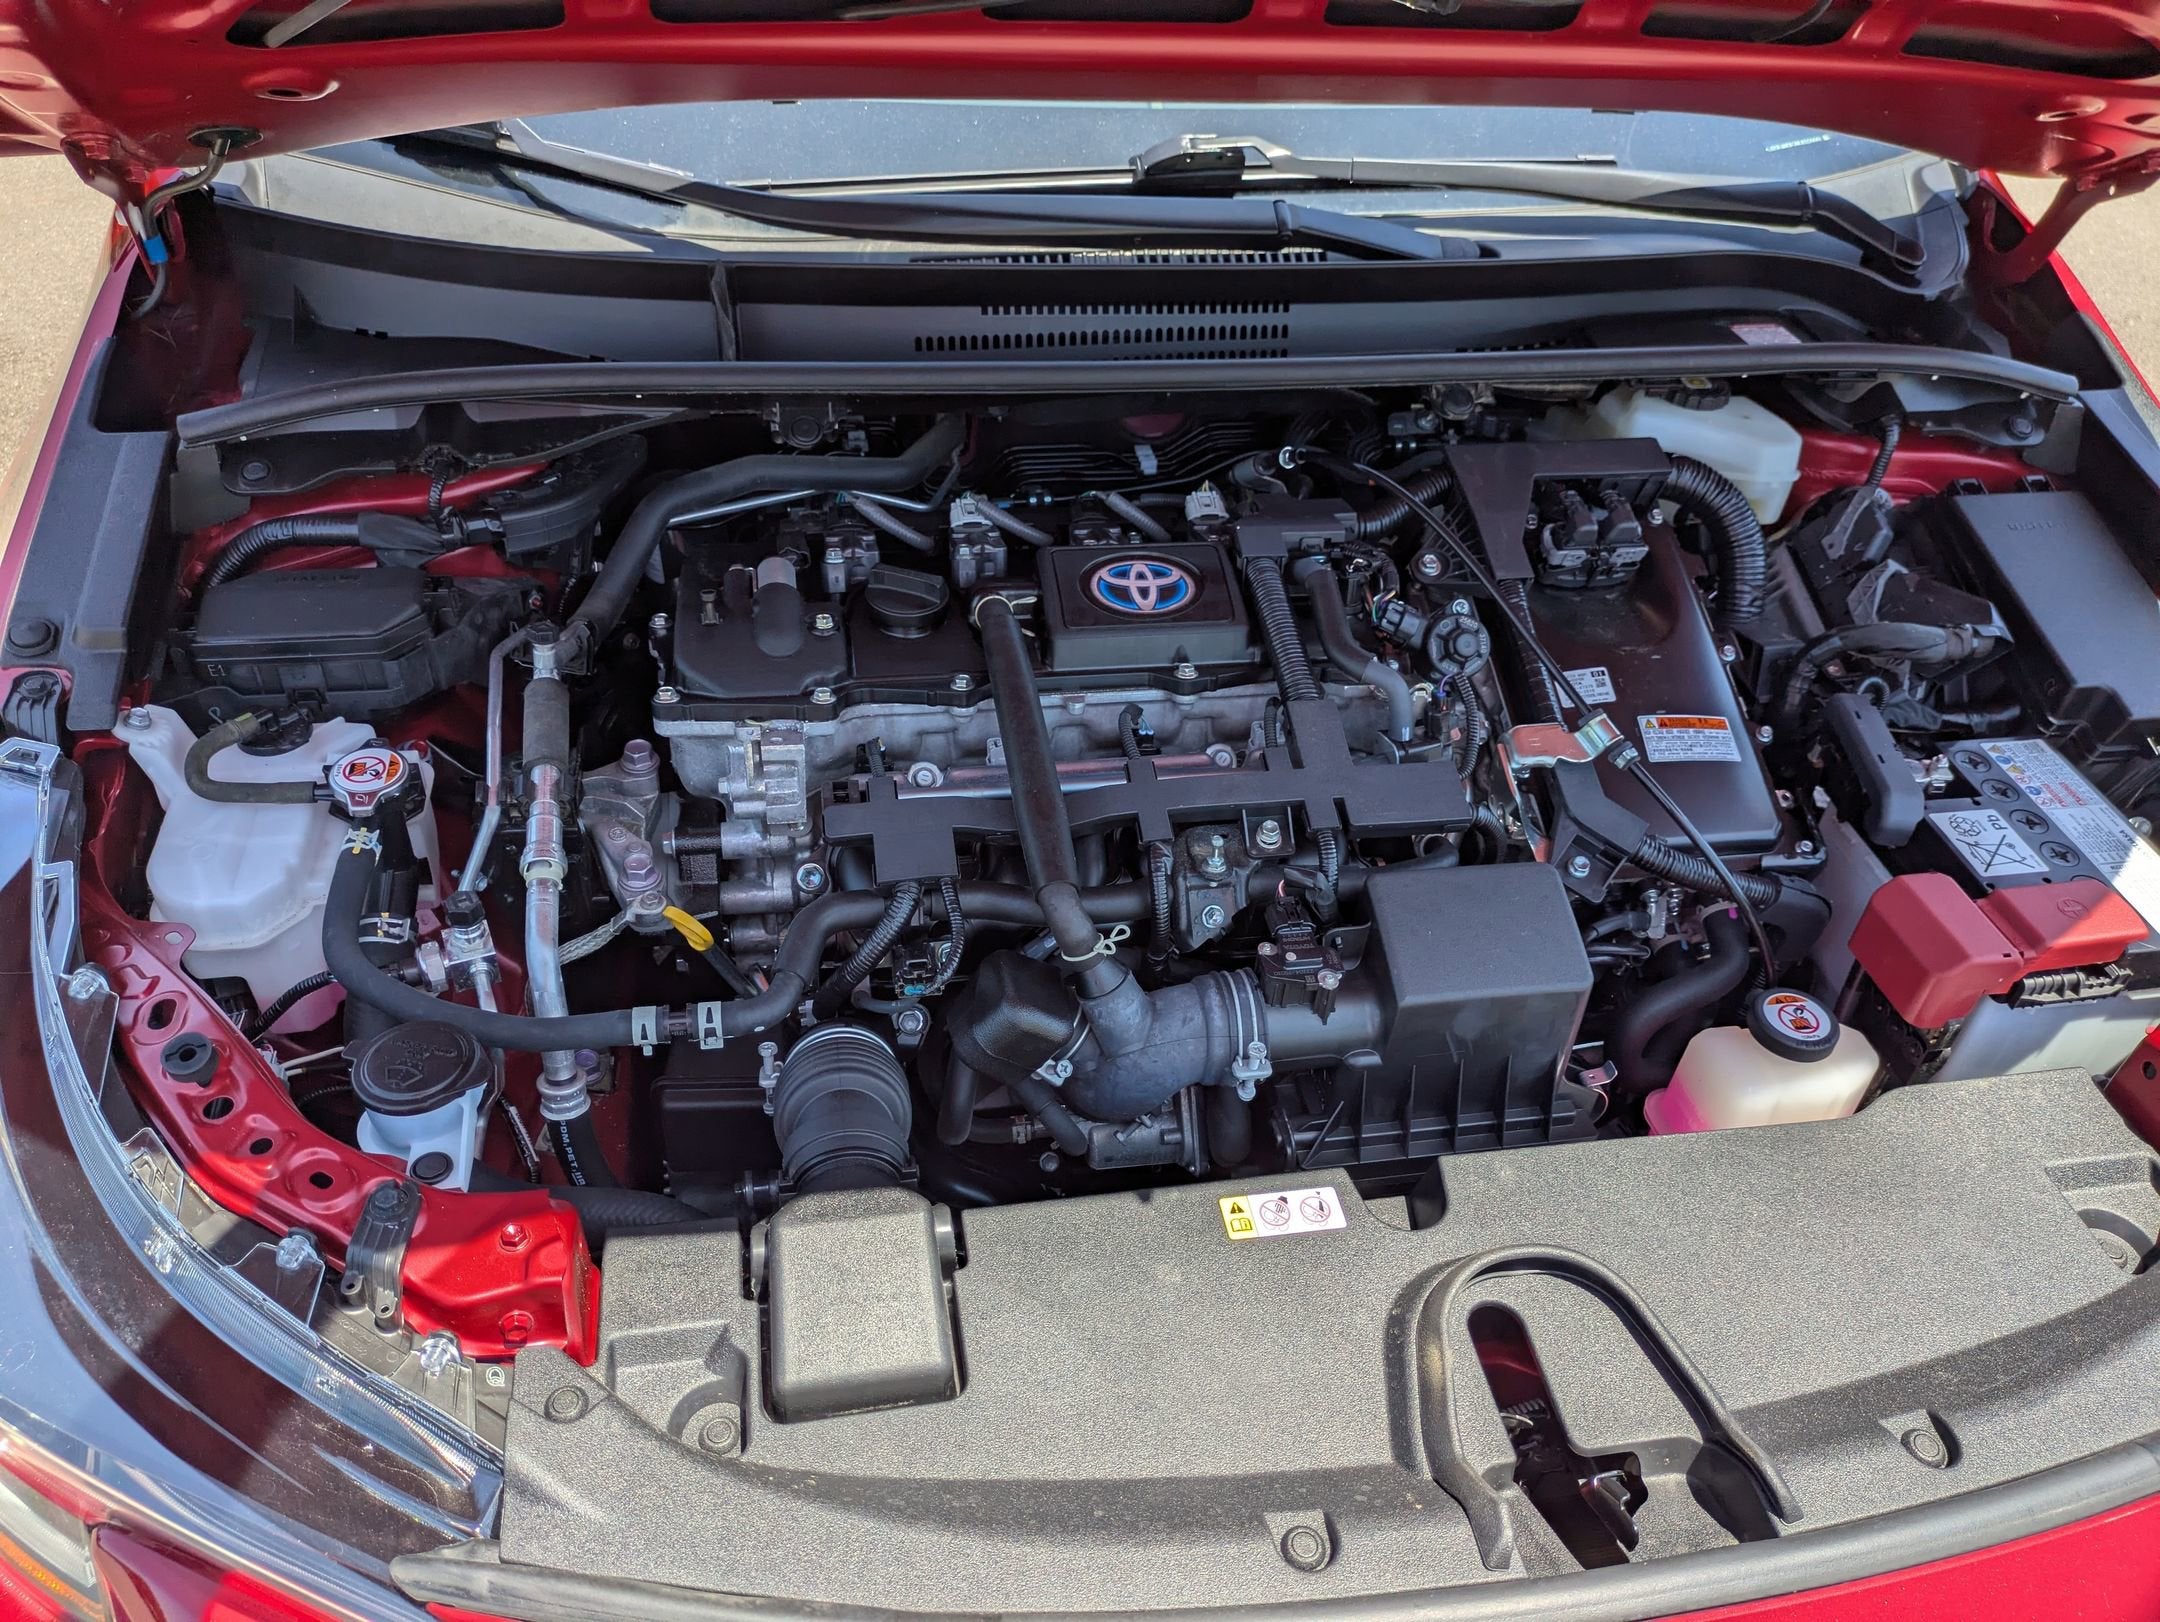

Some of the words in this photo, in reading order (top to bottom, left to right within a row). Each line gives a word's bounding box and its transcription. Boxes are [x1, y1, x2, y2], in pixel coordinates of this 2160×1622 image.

[1459, 616, 1478, 629] 25620
[207, 664, 226, 677] E1
[1987, 814, 2008, 830] Pb
